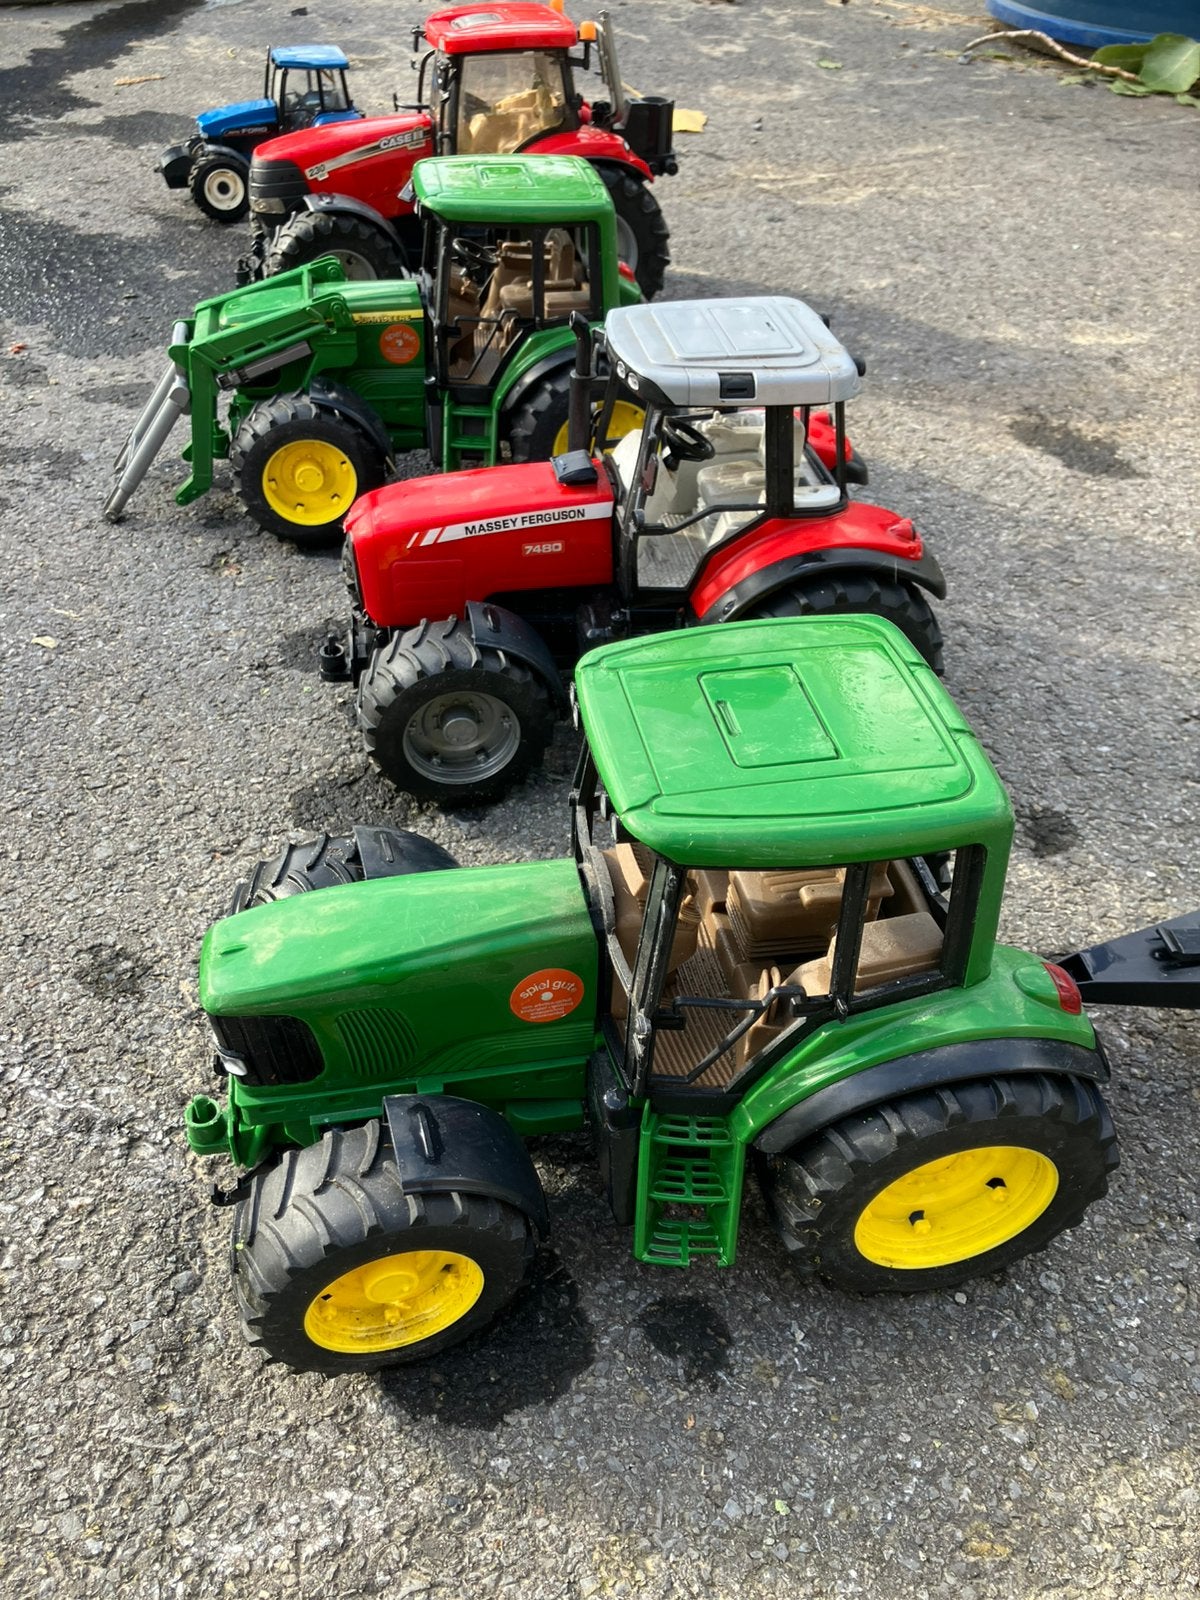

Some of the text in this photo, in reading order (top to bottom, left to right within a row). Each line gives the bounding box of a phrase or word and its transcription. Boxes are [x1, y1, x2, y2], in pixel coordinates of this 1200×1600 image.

[380, 133, 412, 149] CASE
[464, 508, 585, 535] MASSEY FERGUSON
[523, 542, 562, 554] 7480
[520, 979, 577, 999] spiel gute
